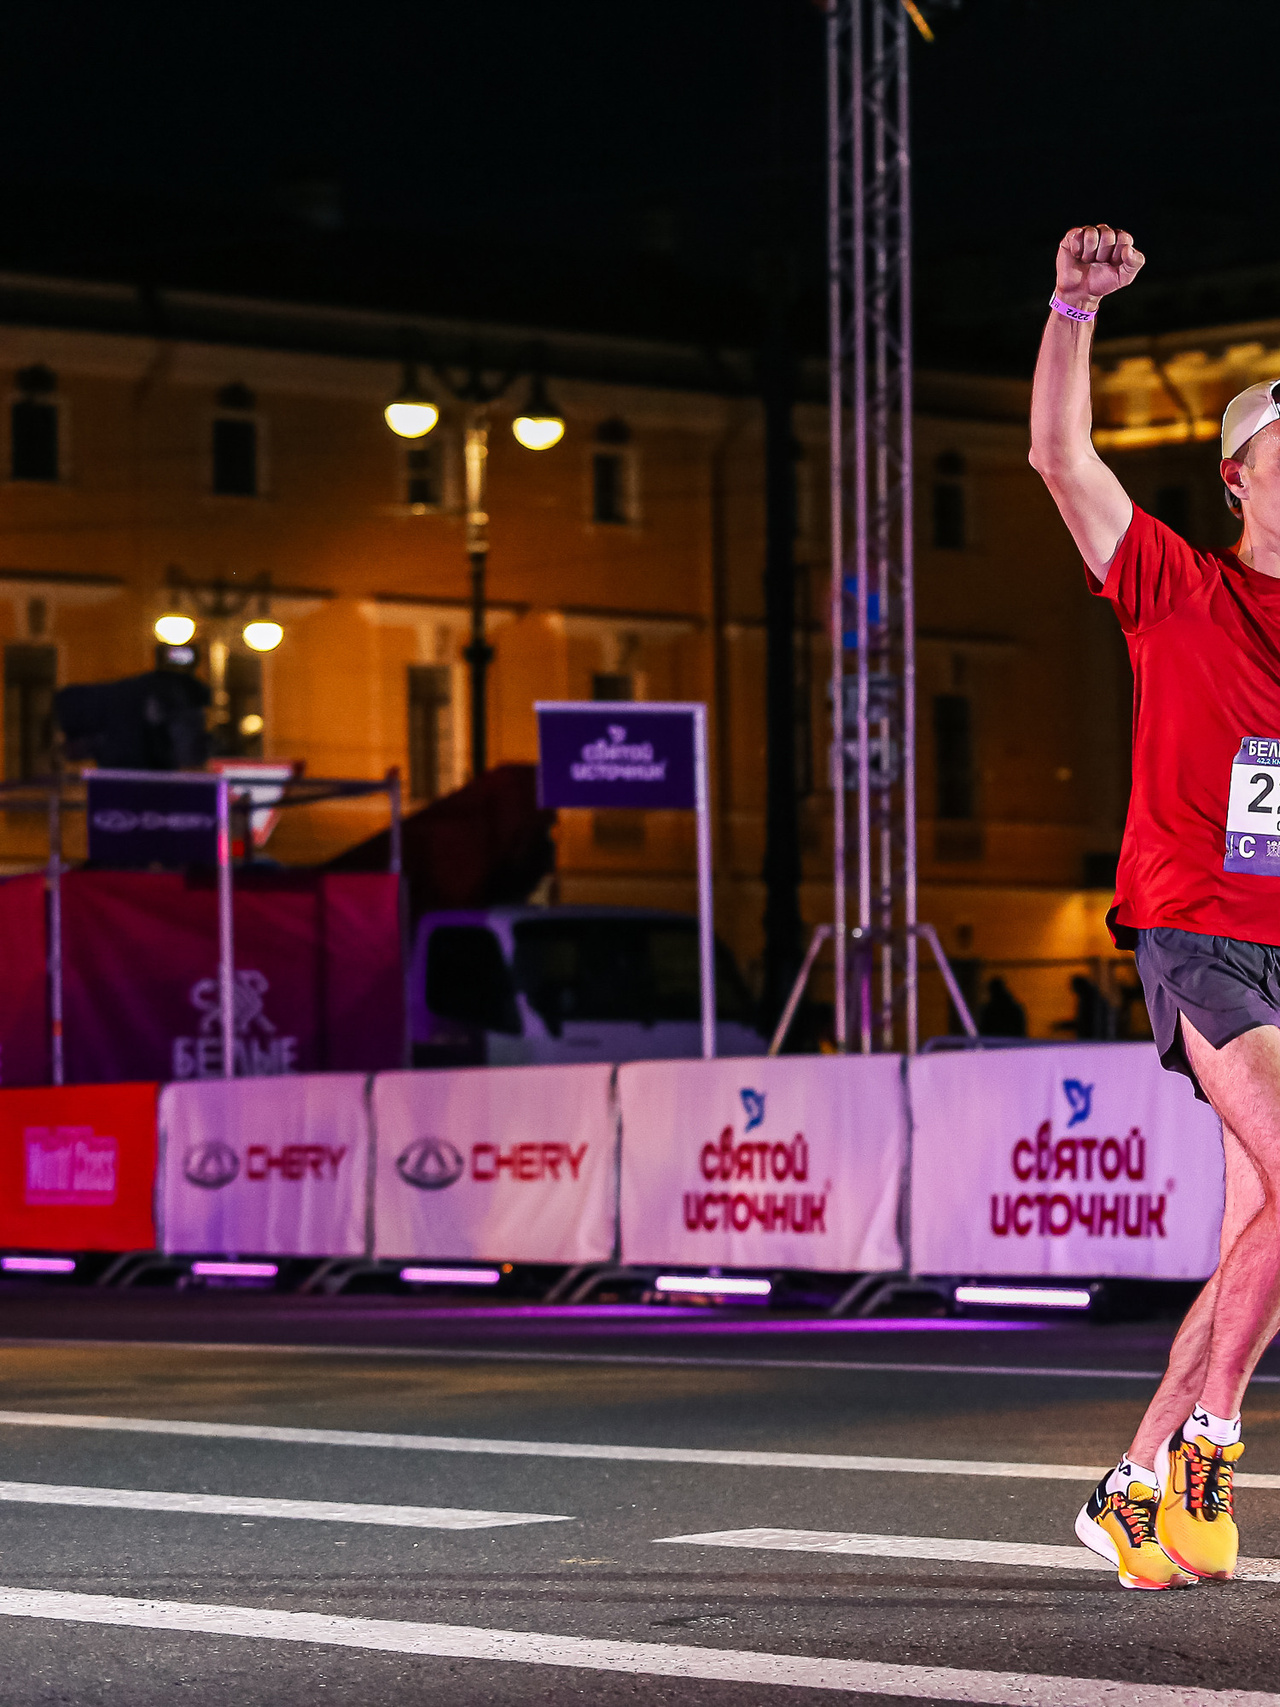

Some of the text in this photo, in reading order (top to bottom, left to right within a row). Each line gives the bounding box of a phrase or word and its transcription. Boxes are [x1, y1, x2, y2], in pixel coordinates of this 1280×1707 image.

[1066, 308, 1090, 320] 2272
[246, 1144, 348, 1181] CHERY
[471, 1142, 588, 1182] CHERY
